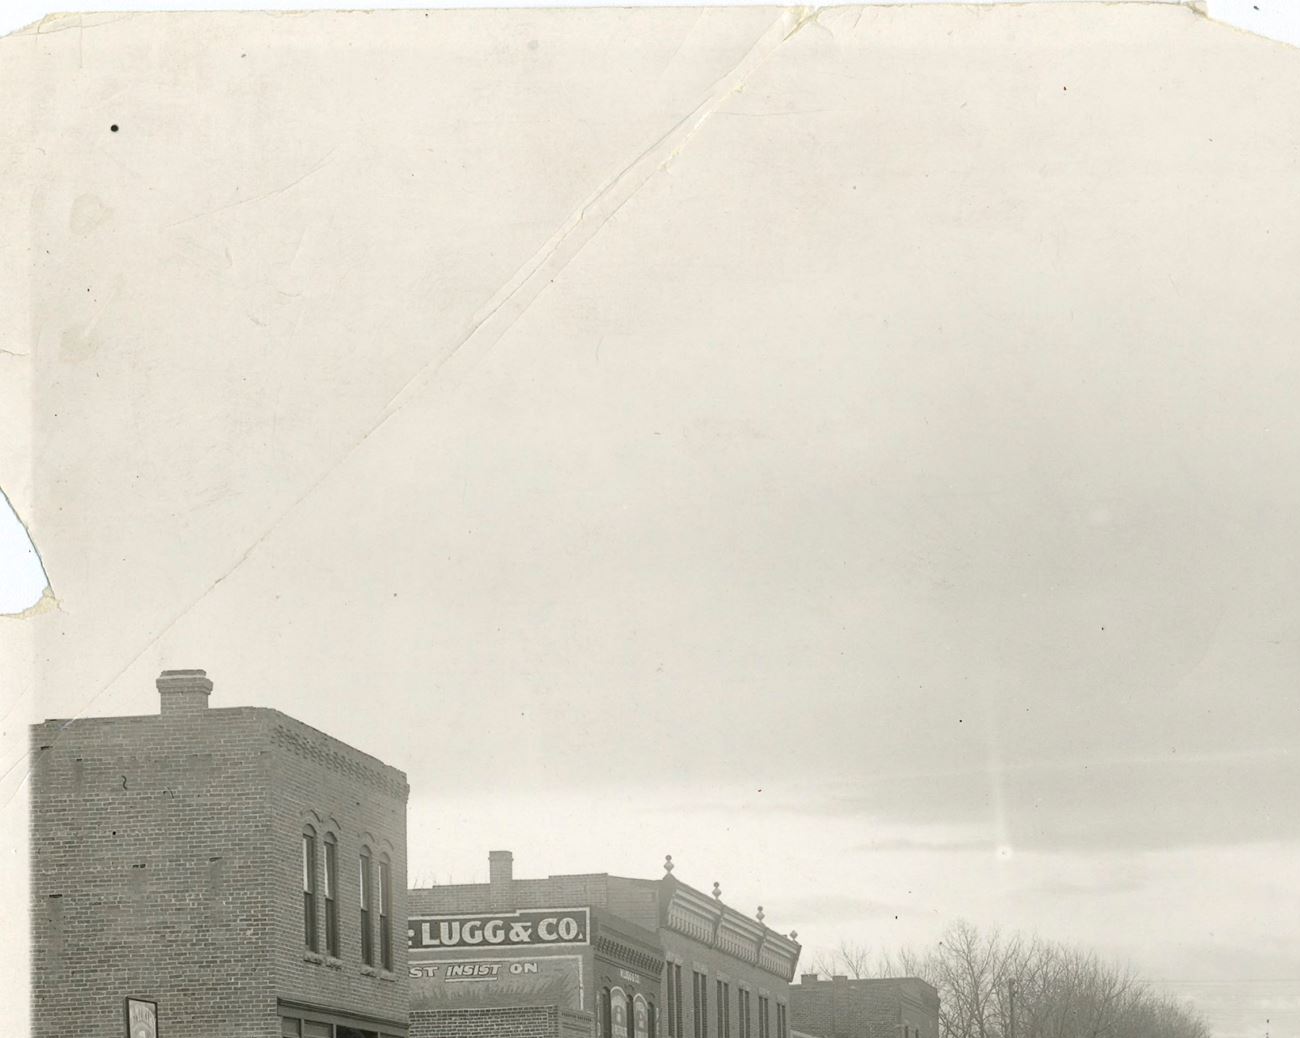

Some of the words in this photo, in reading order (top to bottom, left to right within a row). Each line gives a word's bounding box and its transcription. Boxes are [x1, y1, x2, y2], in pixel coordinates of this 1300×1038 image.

[421, 919, 505, 946] LUGG
[509, 922, 532, 943] &
[446, 964, 502, 977] INSIST
[509, 962, 538, 974] ON
